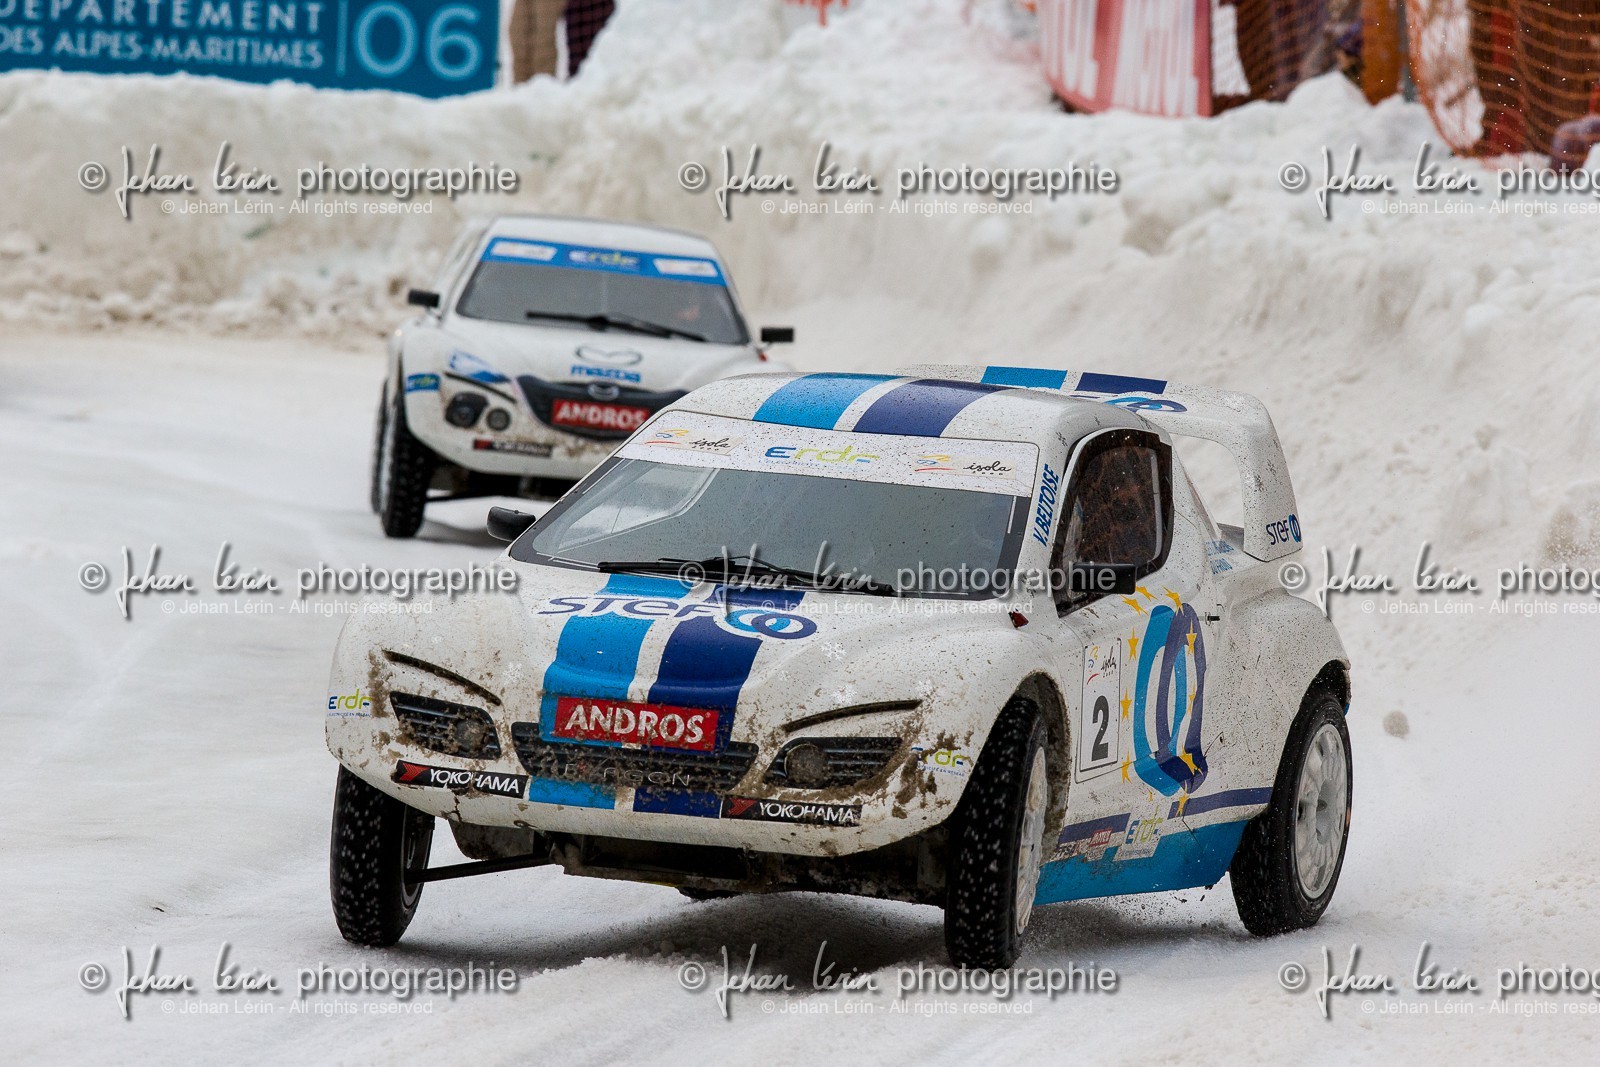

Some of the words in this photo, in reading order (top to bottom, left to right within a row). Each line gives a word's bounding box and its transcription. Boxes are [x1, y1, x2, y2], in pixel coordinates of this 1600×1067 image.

[53, 31, 324, 69] ALPES-MARITIMES
[353, 3, 482, 81] 06
[556, 402, 647, 430] ANDROS
[963, 460, 1012, 472] isola
[565, 704, 704, 744] ANDROS
[1091, 695, 1110, 762] 2
[430, 768, 519, 794] YOKOHAMA
[759, 802, 854, 823] YOKOHAMA
